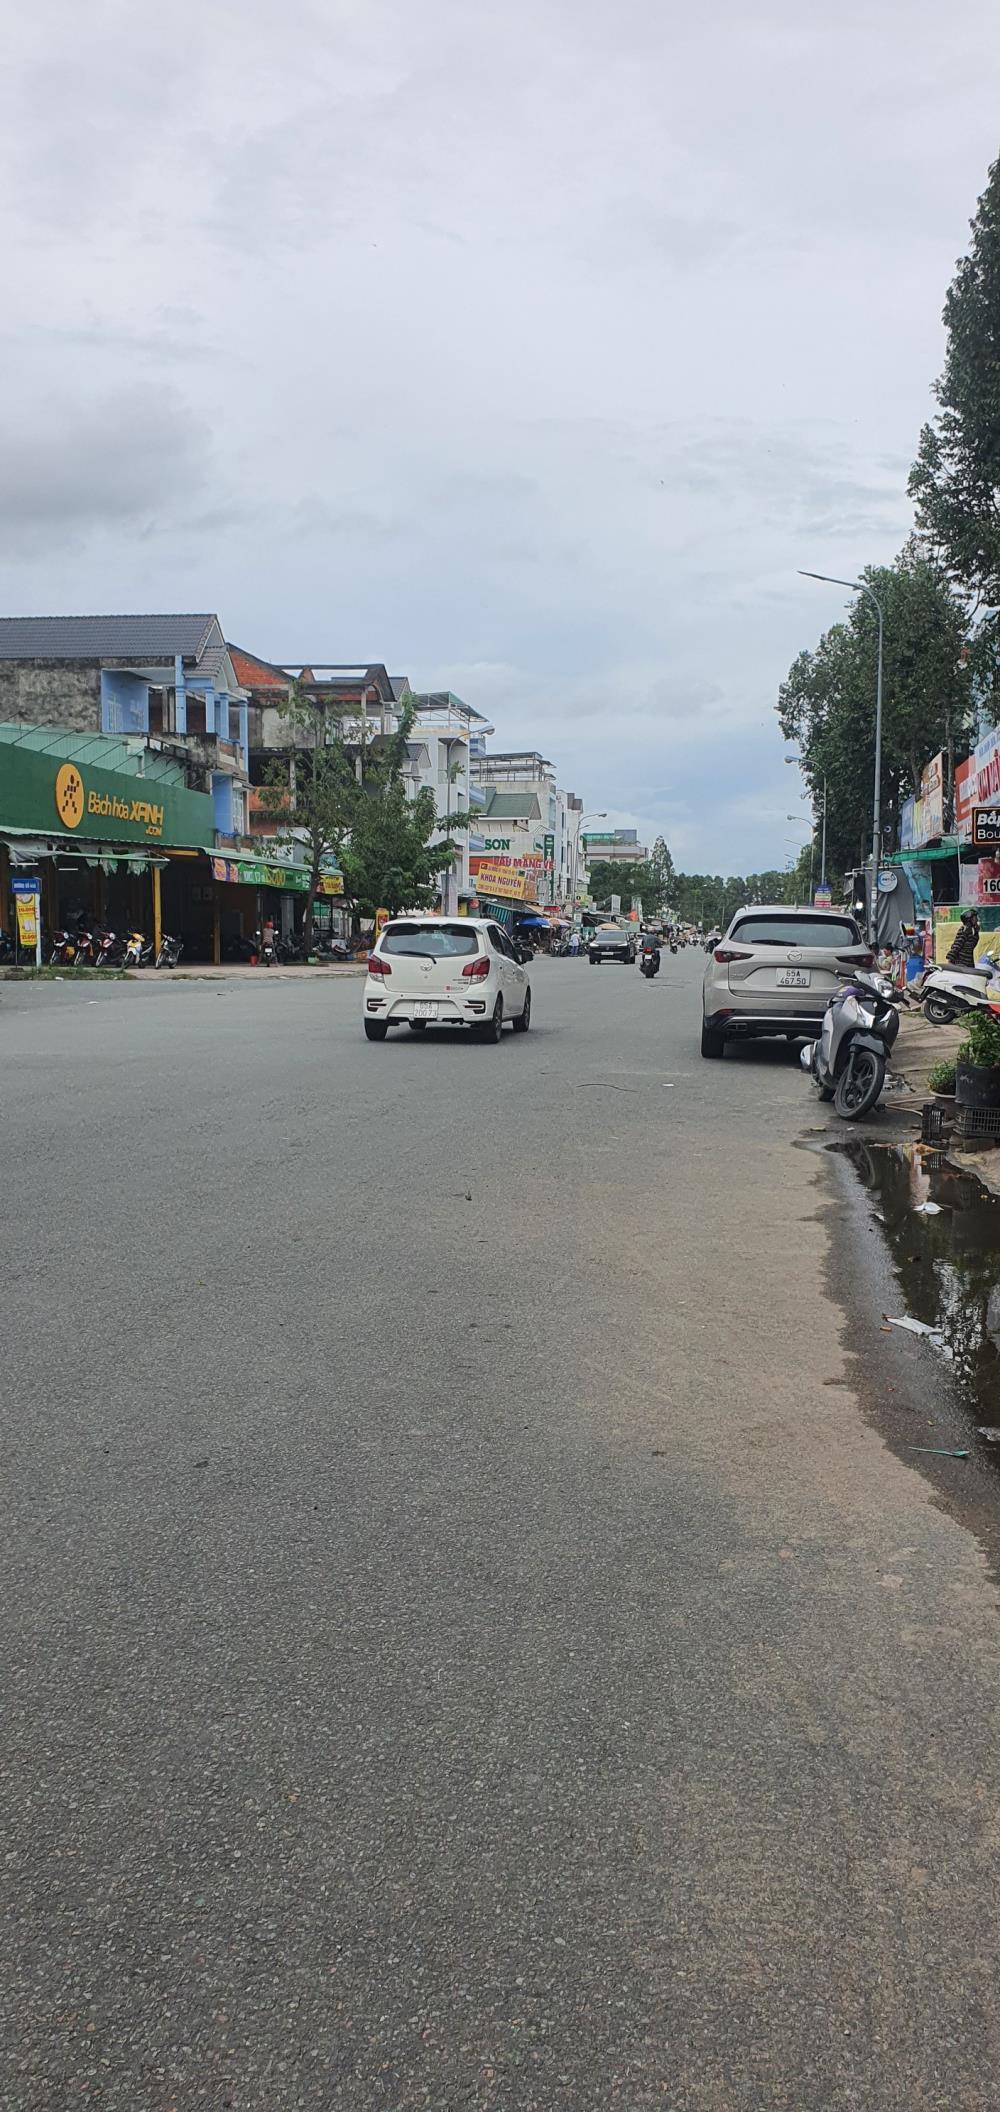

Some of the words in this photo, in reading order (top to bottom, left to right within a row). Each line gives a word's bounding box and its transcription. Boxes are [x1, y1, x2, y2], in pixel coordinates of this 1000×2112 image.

[87, 791, 112, 816] Bách
[112, 796, 129, 819] hóa
[129, 800, 164, 826] XANH
